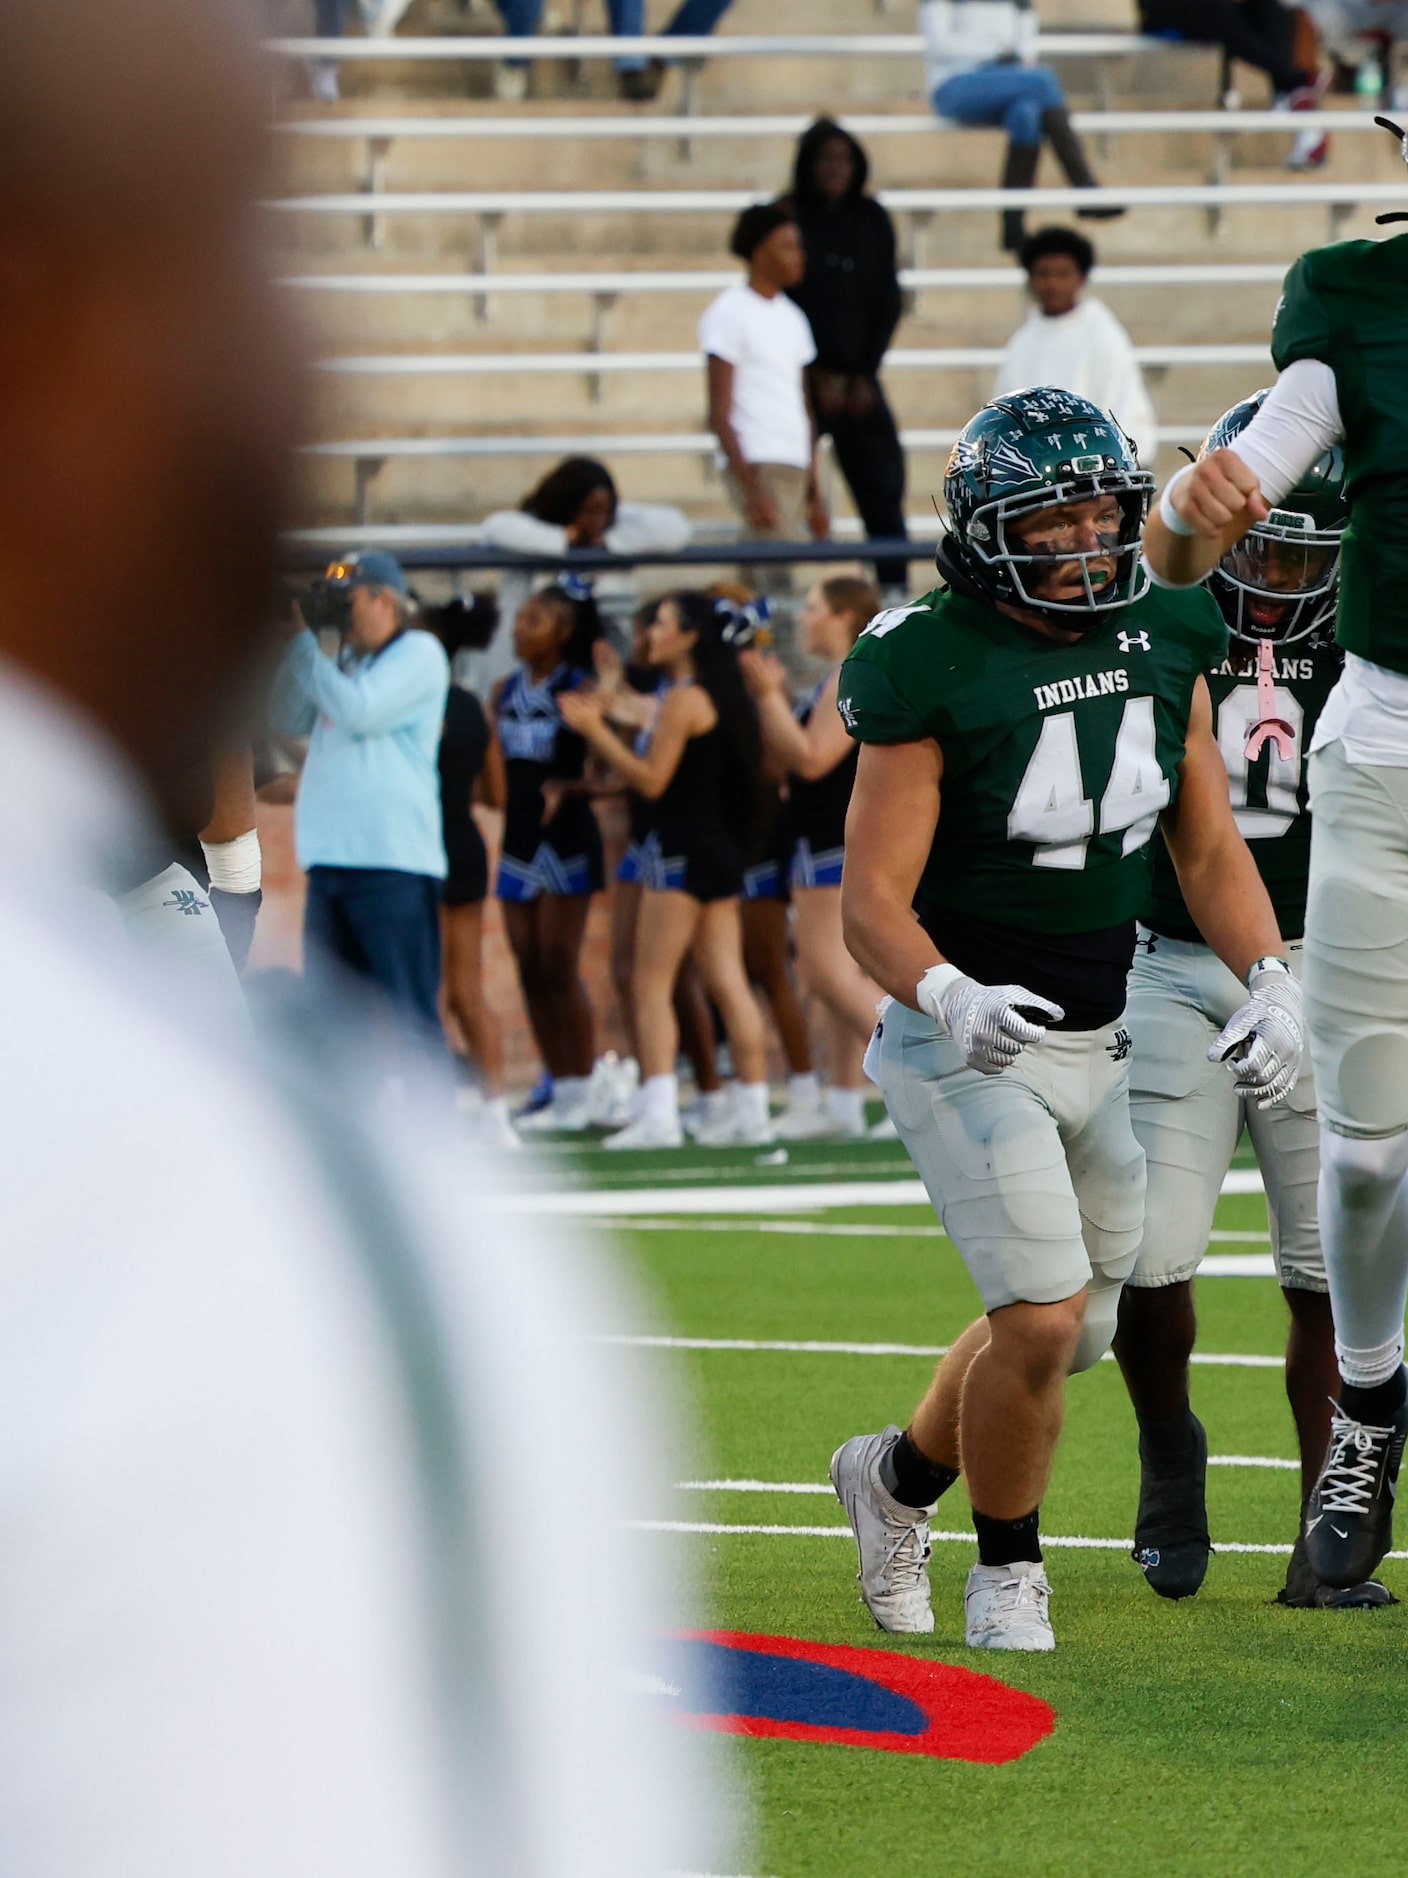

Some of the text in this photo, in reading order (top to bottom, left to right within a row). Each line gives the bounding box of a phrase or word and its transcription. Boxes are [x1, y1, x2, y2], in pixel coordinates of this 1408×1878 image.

[1033, 668, 1130, 710] INDIANS
[1217, 683, 1305, 839] 0
[1007, 695, 1171, 870] 44
